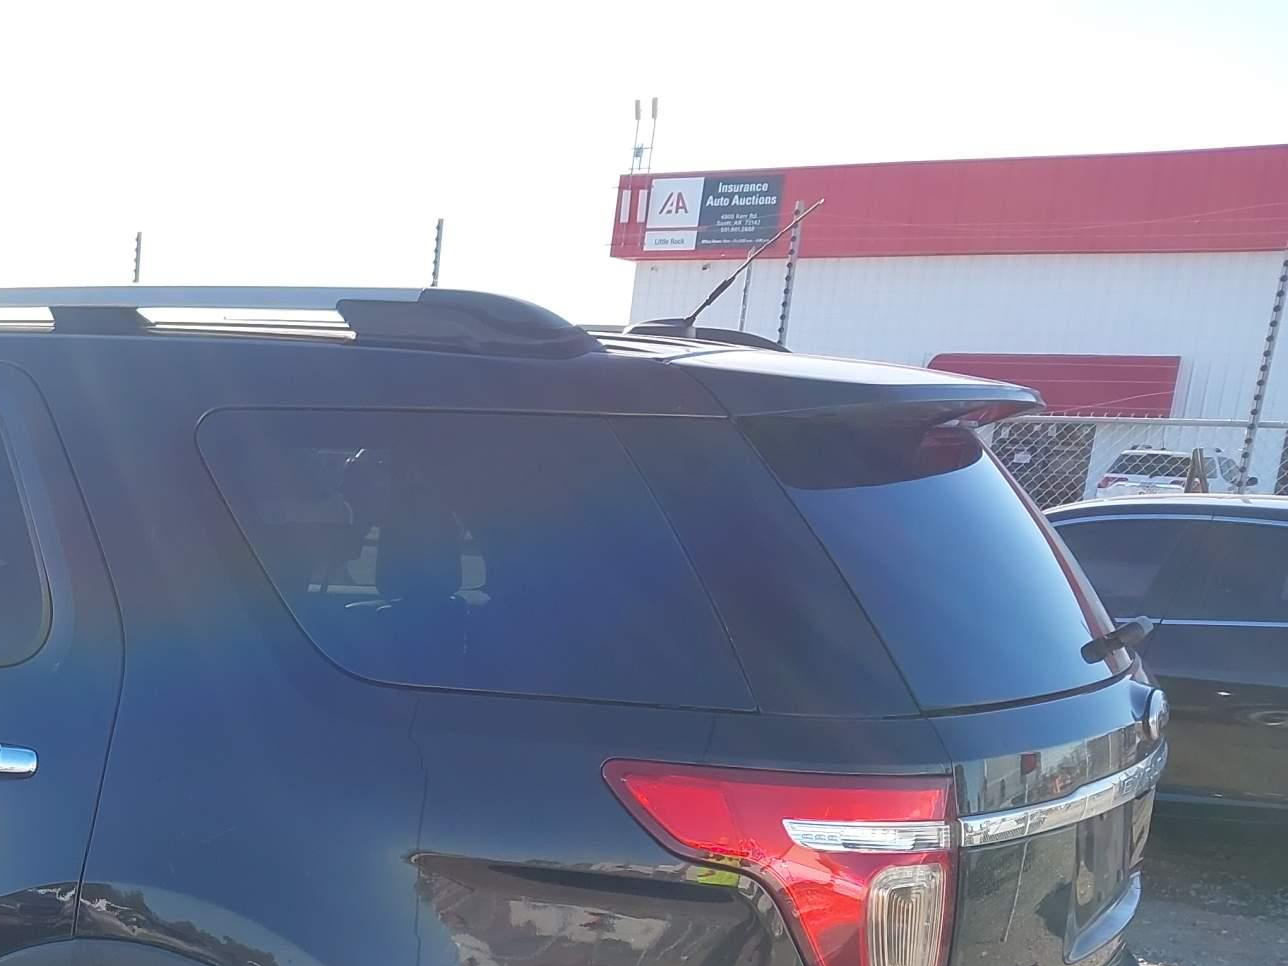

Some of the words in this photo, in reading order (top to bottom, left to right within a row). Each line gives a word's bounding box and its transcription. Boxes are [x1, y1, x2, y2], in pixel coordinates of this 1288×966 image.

[718, 182, 769, 193] Insurance
[706, 195, 729, 207] Auto
[731, 194, 777, 206] Auctions
[654, 238, 669, 246] Little
